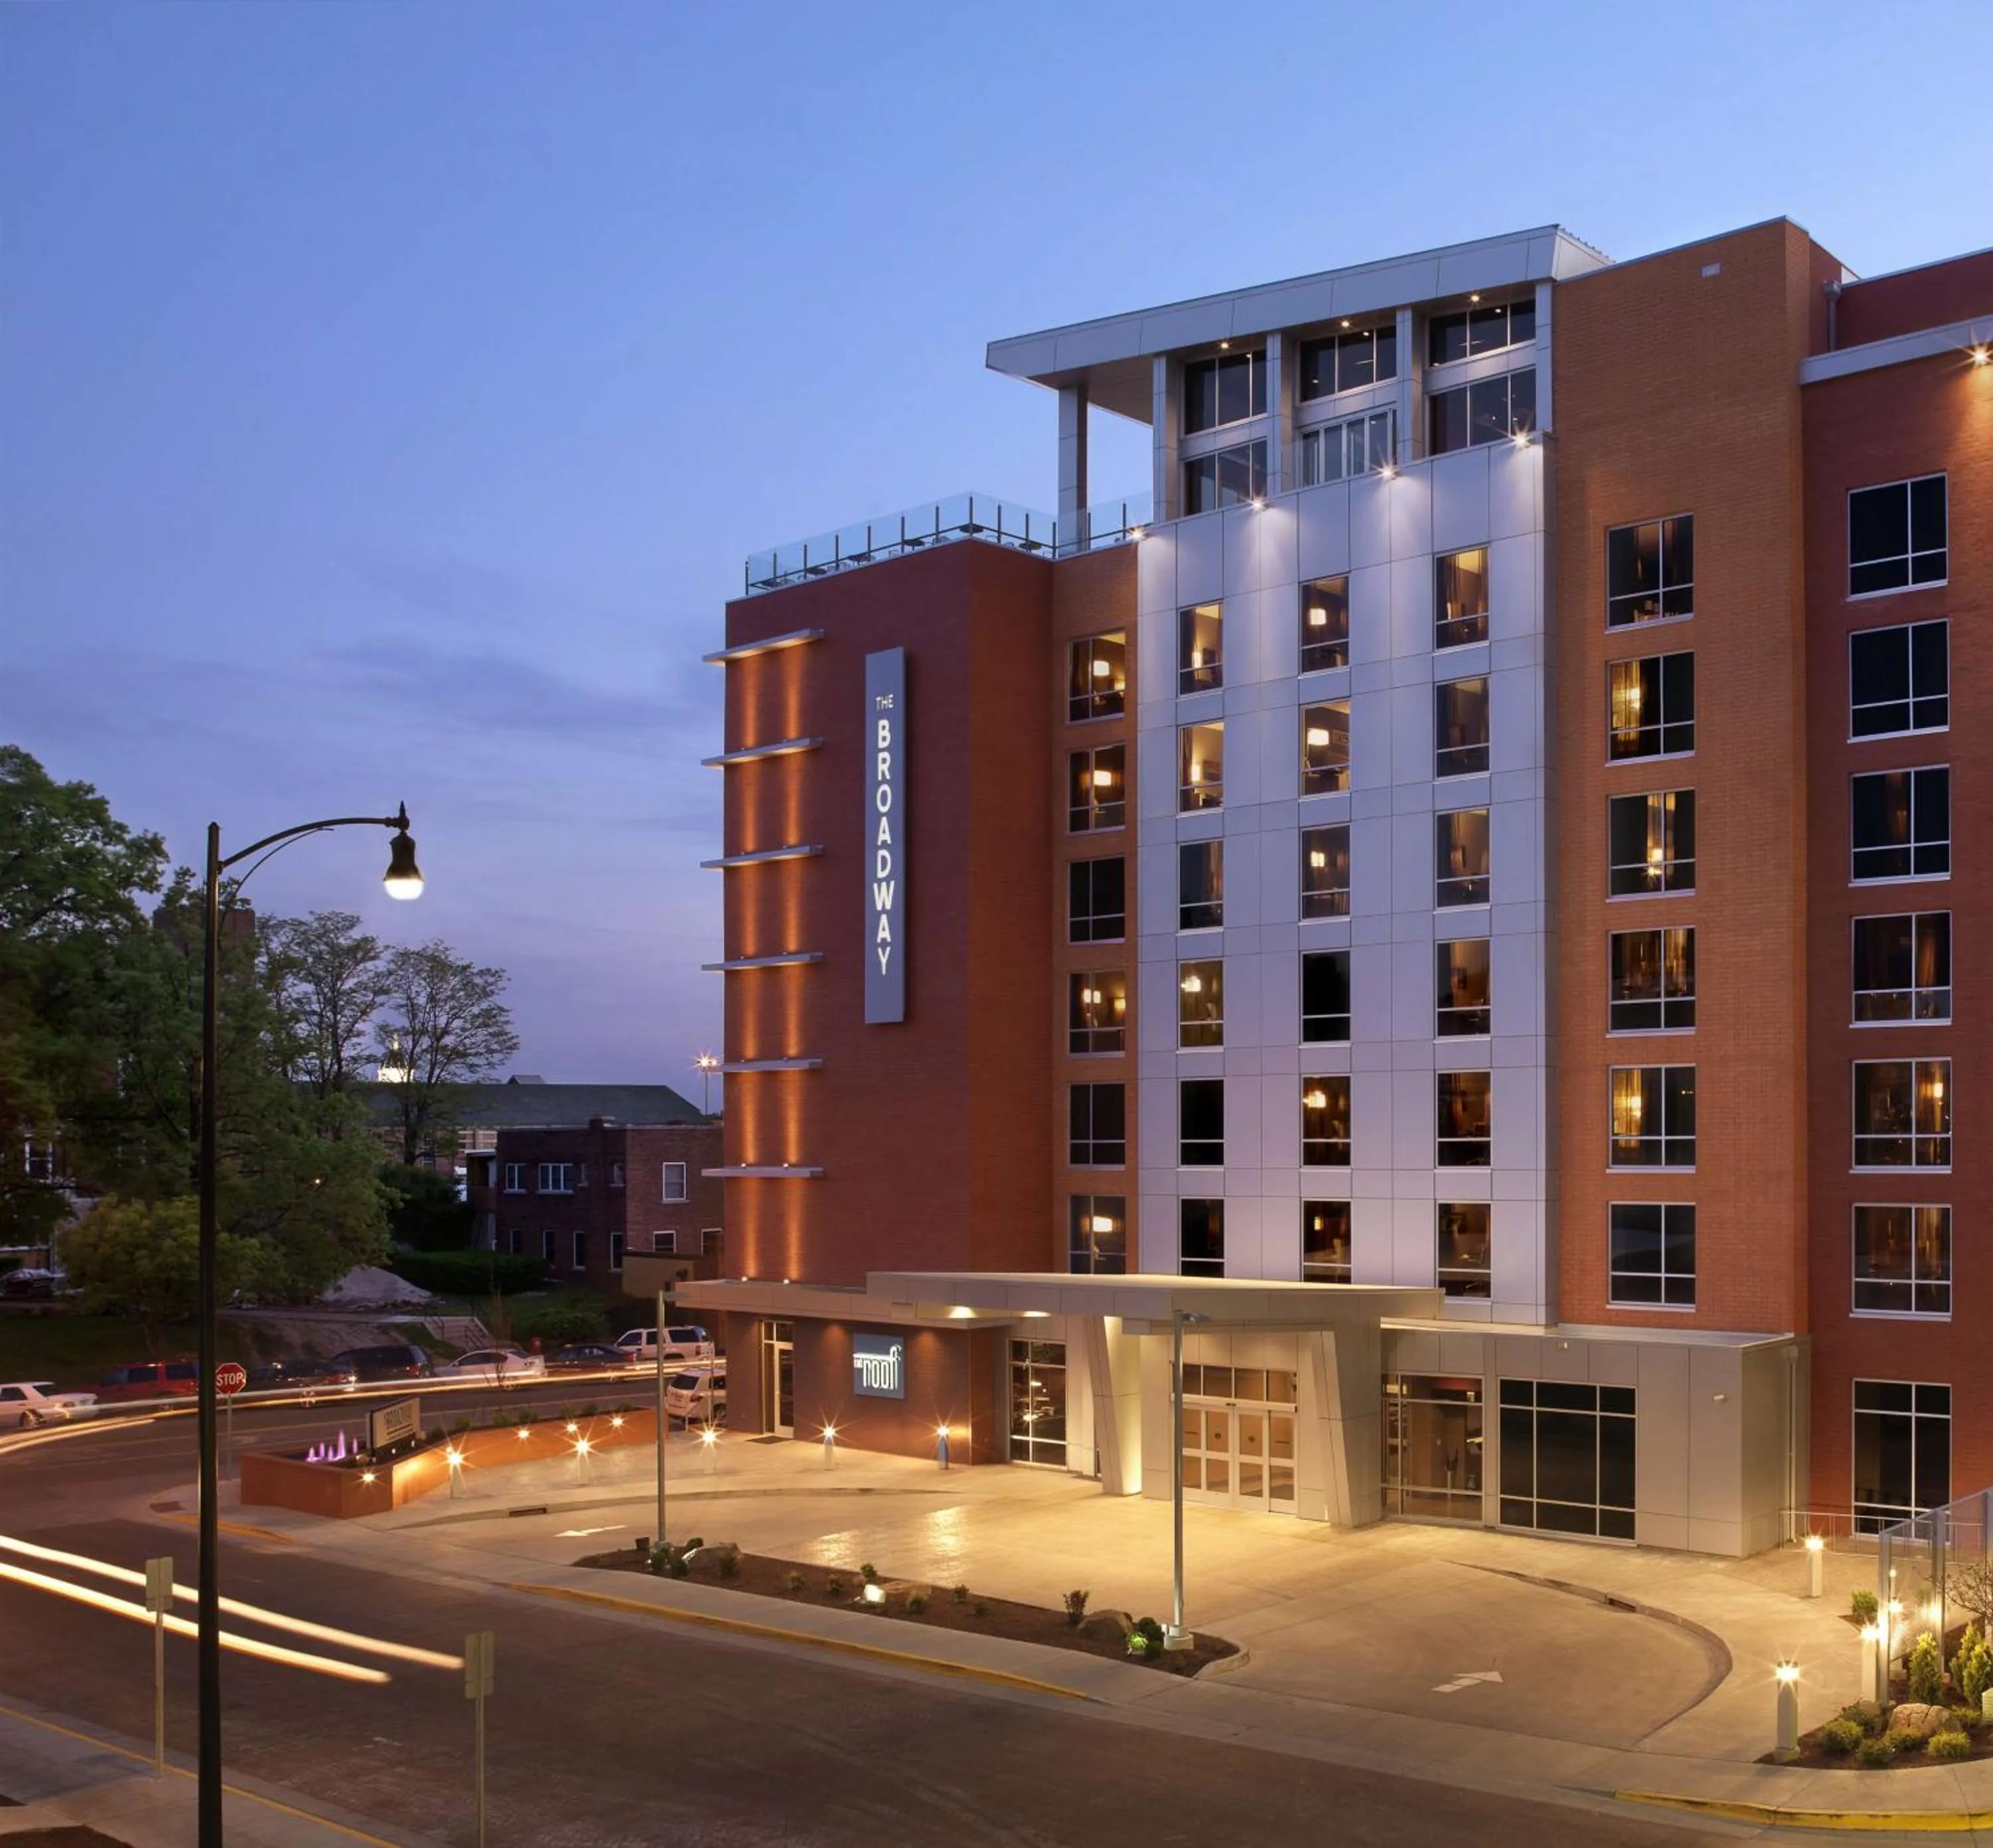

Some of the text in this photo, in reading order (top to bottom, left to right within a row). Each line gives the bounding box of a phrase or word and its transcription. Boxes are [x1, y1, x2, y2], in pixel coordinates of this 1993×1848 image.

[876, 694, 894, 710] THE
[874, 719, 894, 974] BROADWAY
[217, 1372, 244, 1386] STOP
